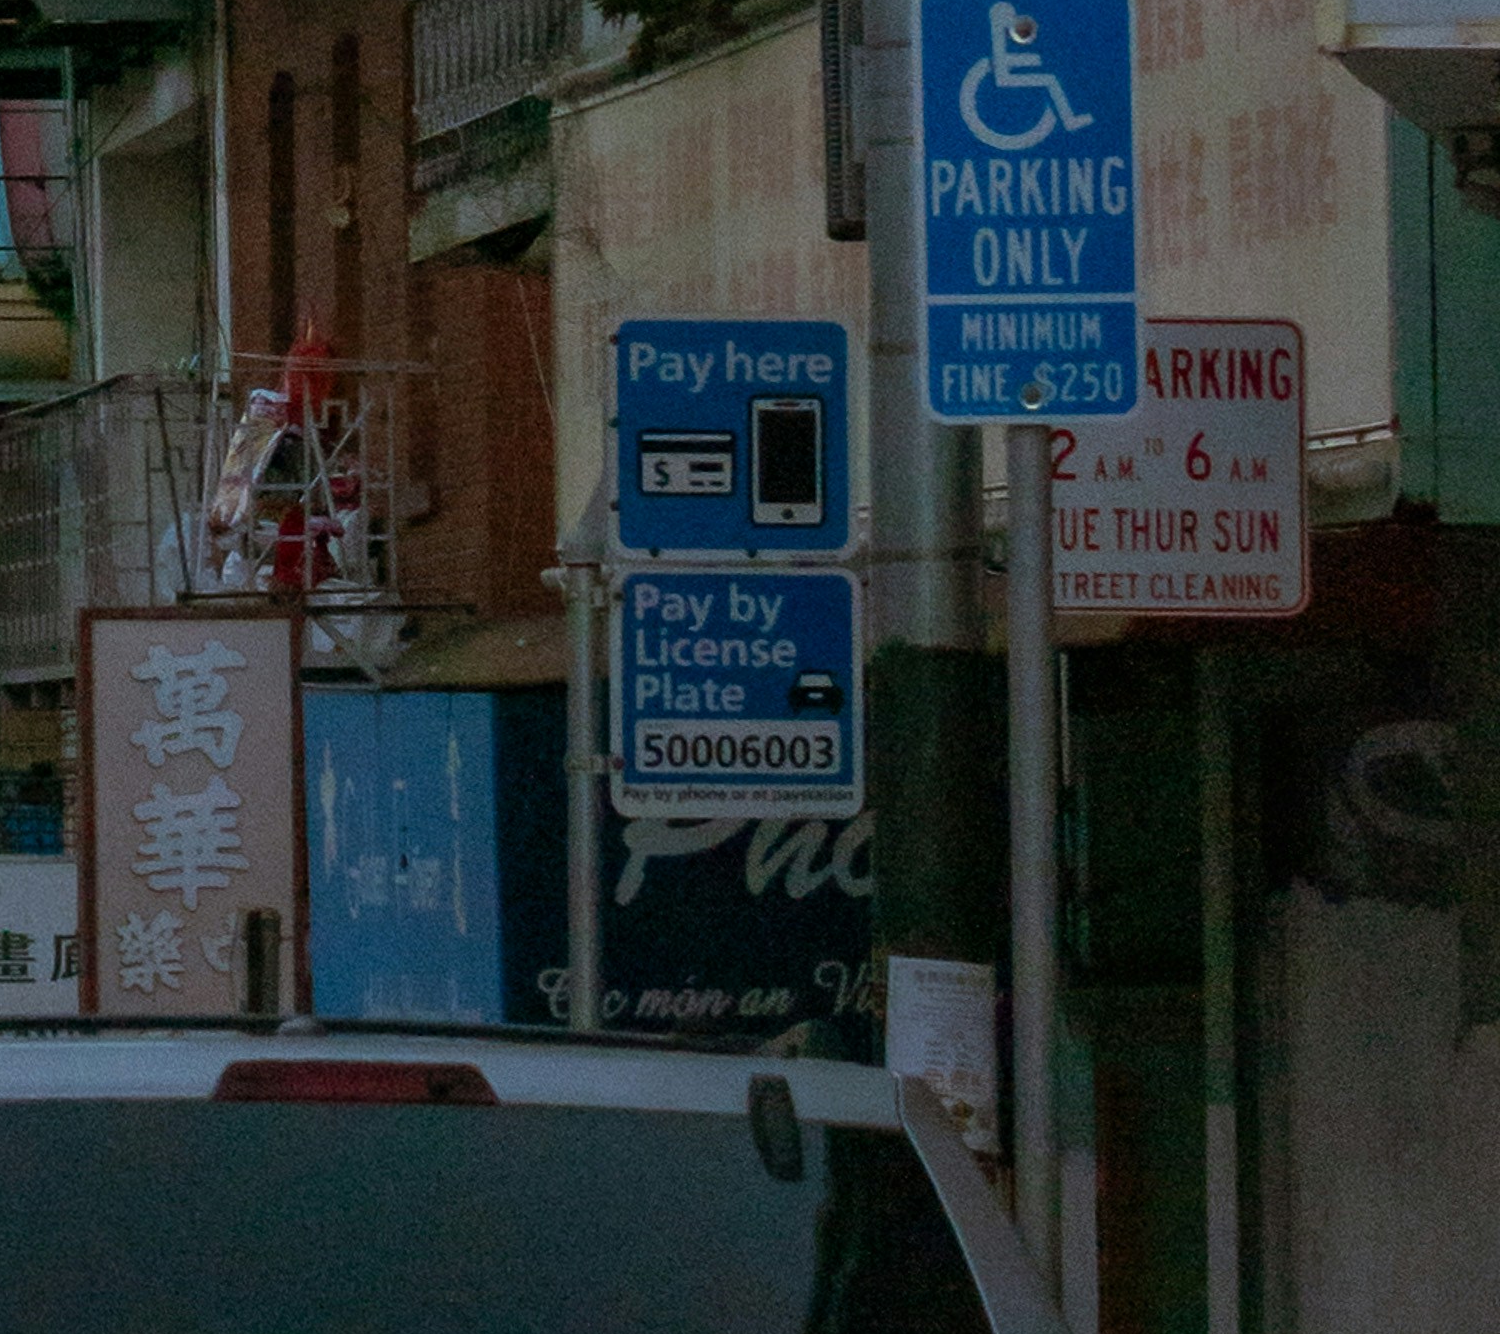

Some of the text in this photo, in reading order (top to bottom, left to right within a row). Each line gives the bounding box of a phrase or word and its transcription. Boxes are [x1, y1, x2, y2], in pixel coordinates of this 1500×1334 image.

[931, 156, 1128, 217] PARKING
[973, 227, 1088, 287] ONLY
[962, 312, 1101, 351] MINIMUM
[628, 342, 834, 391] Pay here
[941, 361, 1123, 407] FINE $250
[1146, 348, 1292, 400] ARKING
[1049, 429, 1076, 480] 2
[1186, 432, 1211, 482] 6
[1053, 508, 1278, 553] UE THUR SUN
[634, 582, 783, 633] Pay by
[1053, 572, 1281, 601] TREET CLEANING
[635, 628, 797, 667] License
[635, 672, 746, 712] Plate
[644, 734, 834, 768] 50006003
[678, 787, 728, 801] phone
